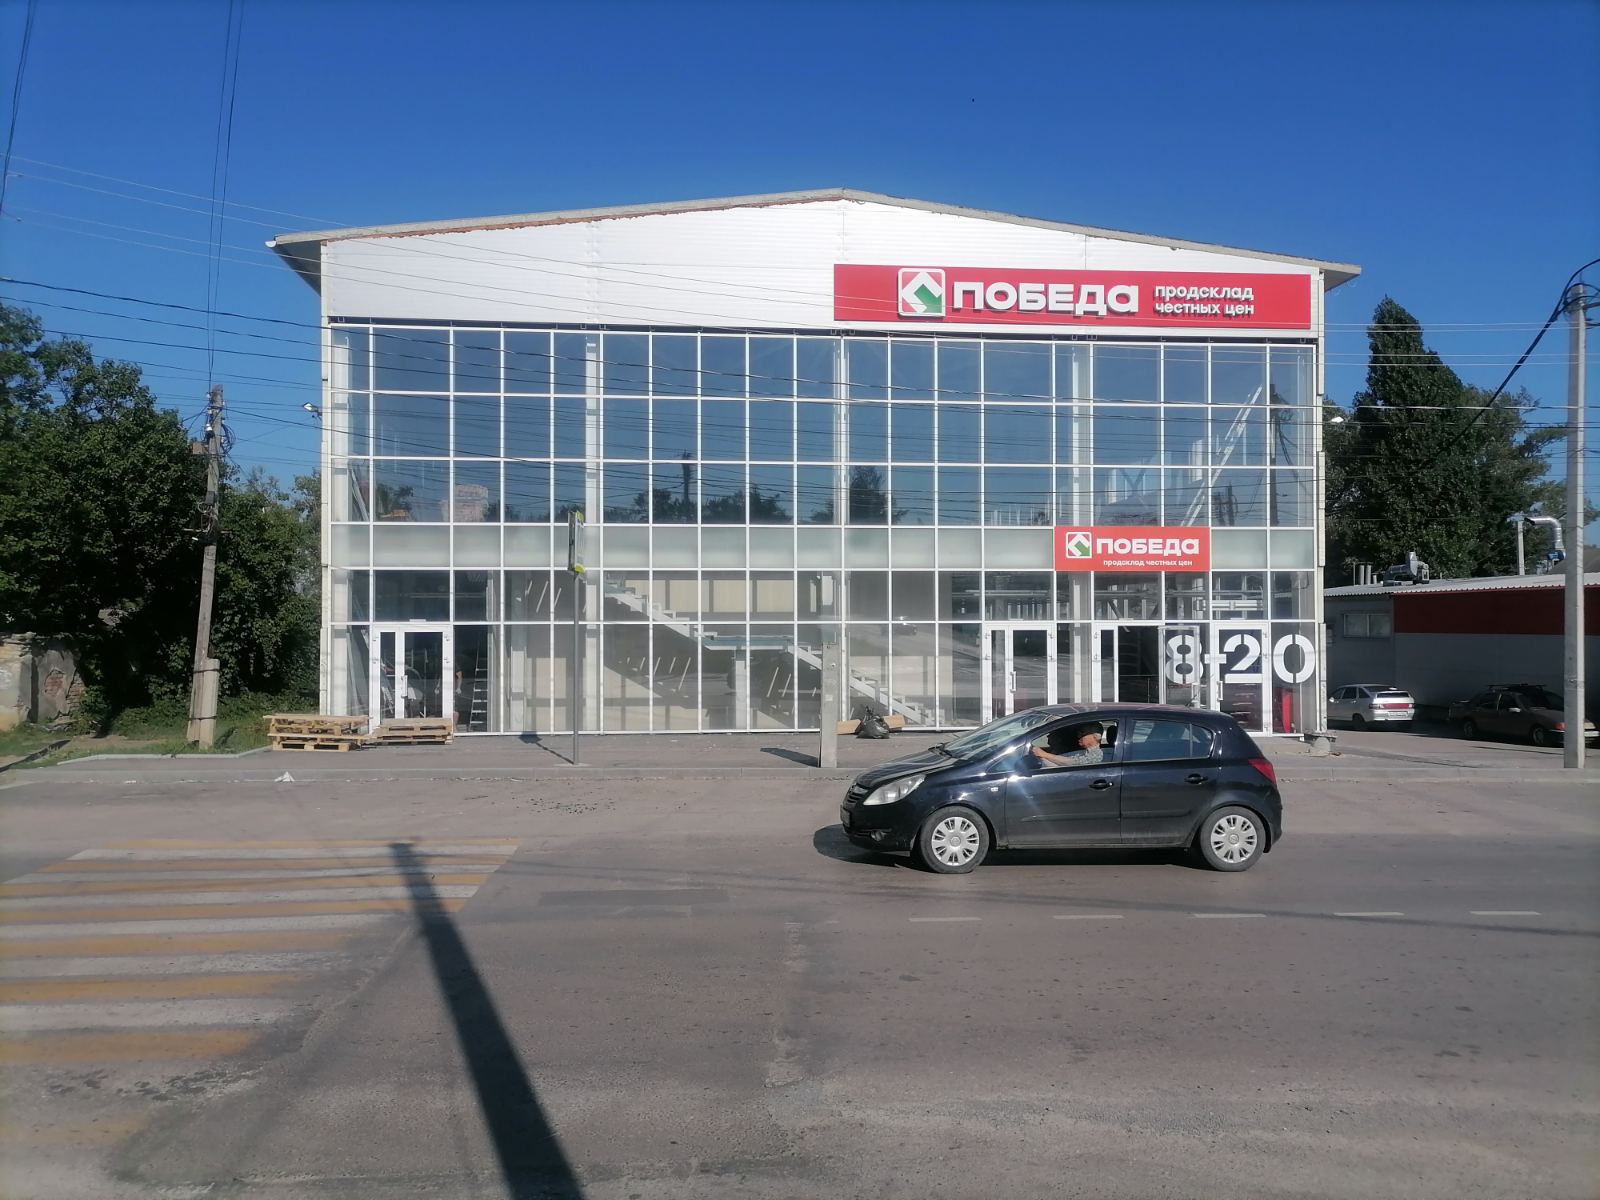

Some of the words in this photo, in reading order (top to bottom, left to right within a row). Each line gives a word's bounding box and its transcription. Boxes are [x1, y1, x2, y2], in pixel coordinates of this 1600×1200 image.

[953, 281, 1139, 316] ПОБЕДА
[1154, 285, 1254, 302] продсклад
[1154, 302, 1221, 314] честных
[1224, 303, 1254, 316] цен
[1096, 537, 1200, 557] ПОБЕДА
[1103, 559, 1145, 568] продсклад
[1145, 559, 1177, 567] честных
[1178, 560, 1193, 568] цен
